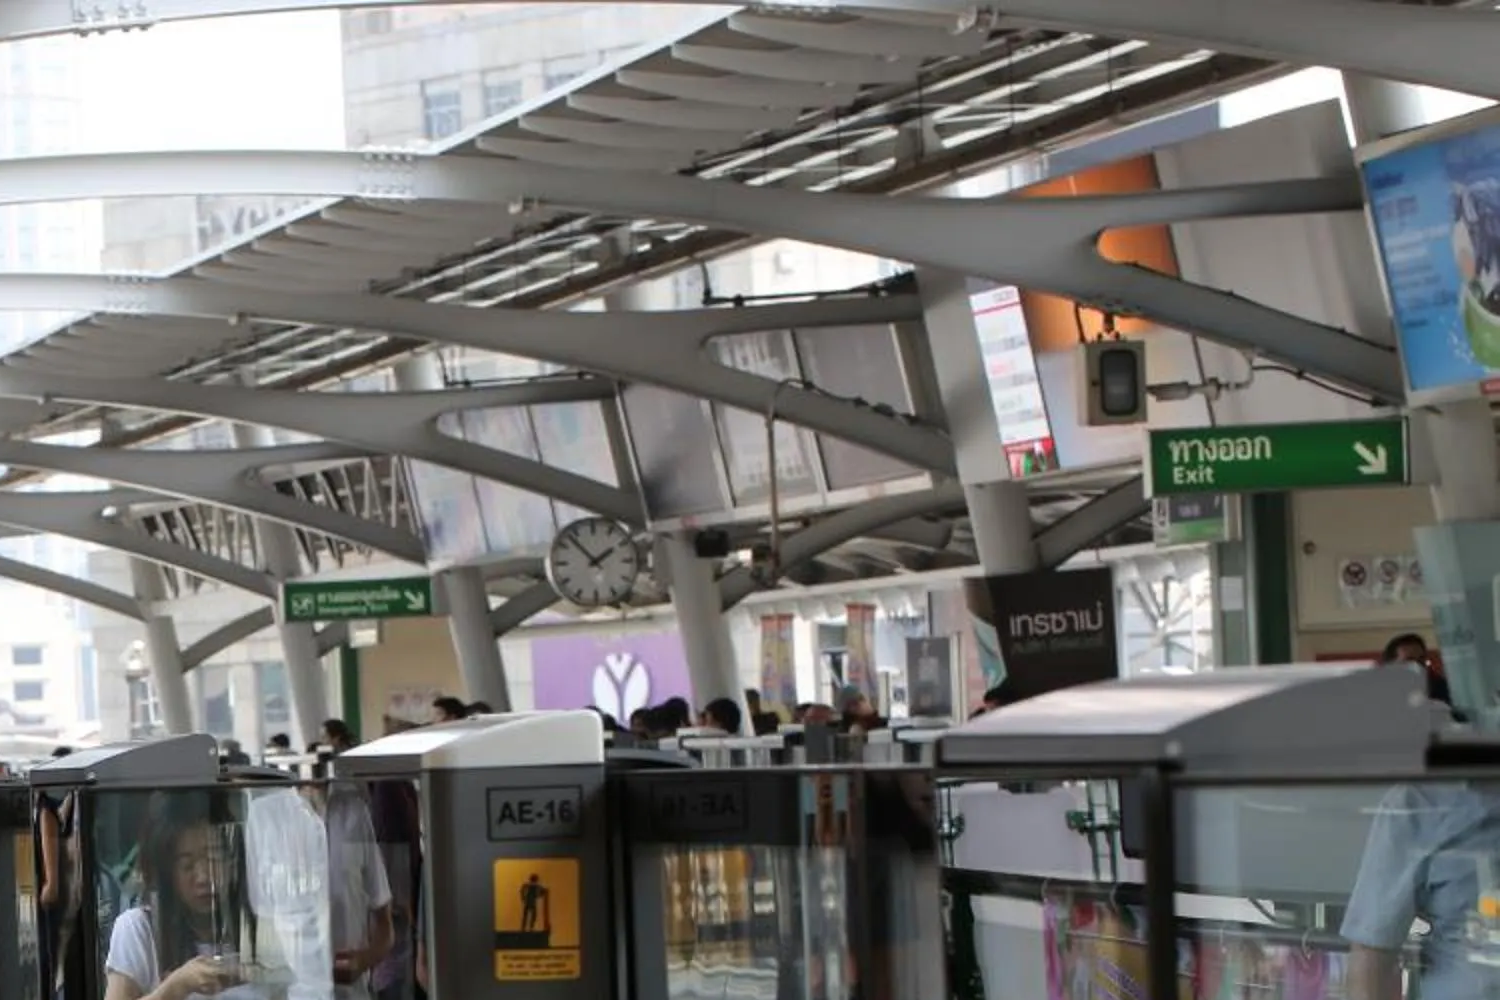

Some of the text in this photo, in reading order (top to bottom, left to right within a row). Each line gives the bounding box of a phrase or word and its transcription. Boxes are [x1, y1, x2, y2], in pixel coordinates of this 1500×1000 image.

[1168, 435, 1273, 464] ทางออก
[1172, 466, 1215, 485] Exit
[498, 800, 576, 825] AE-16
